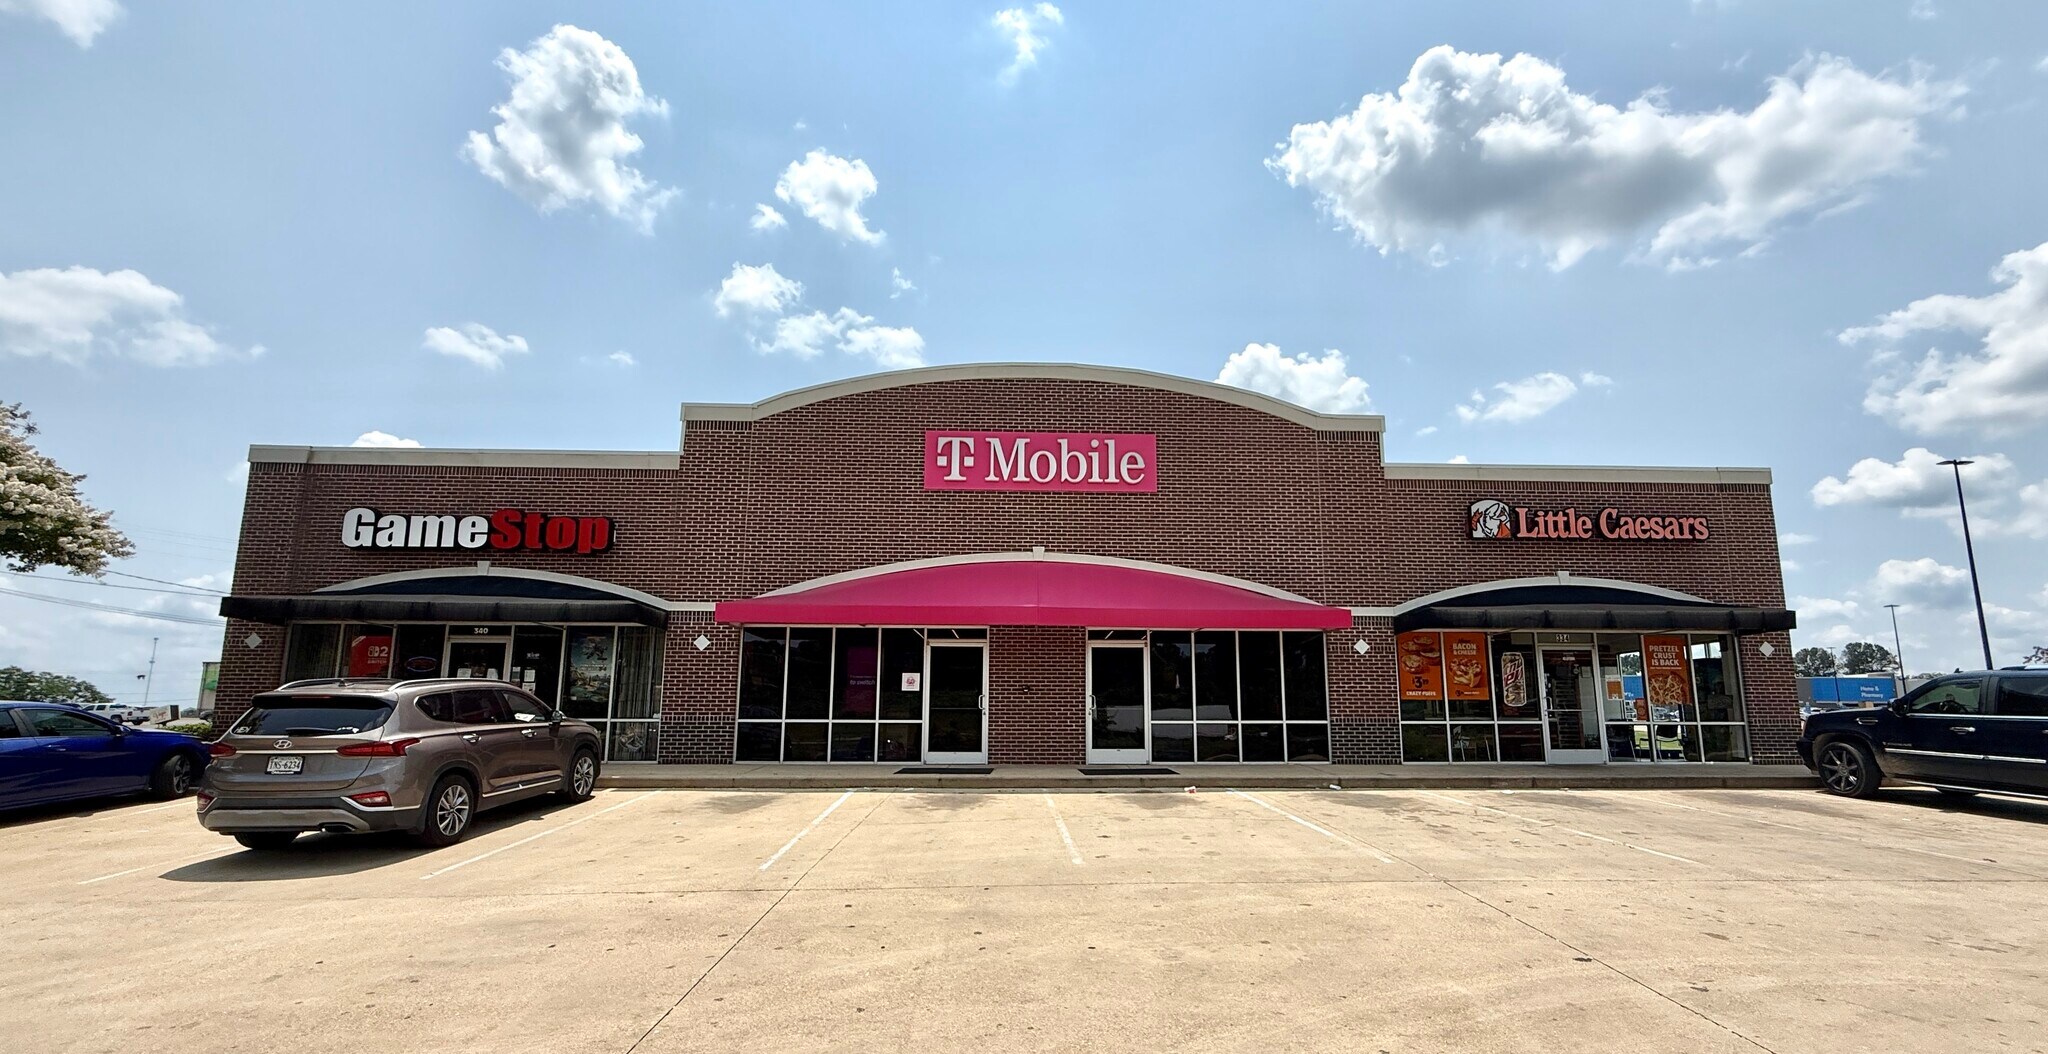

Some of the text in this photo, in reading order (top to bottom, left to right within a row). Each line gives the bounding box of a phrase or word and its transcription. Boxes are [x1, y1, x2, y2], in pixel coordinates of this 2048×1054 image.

[984, 438, 1146, 484] Mobile
[341, 507, 610, 554] GameStop
[1515, 507, 1710, 540] Little Caesars
[473, 627, 489, 635] 340
[379, 645, 389, 657] 2
